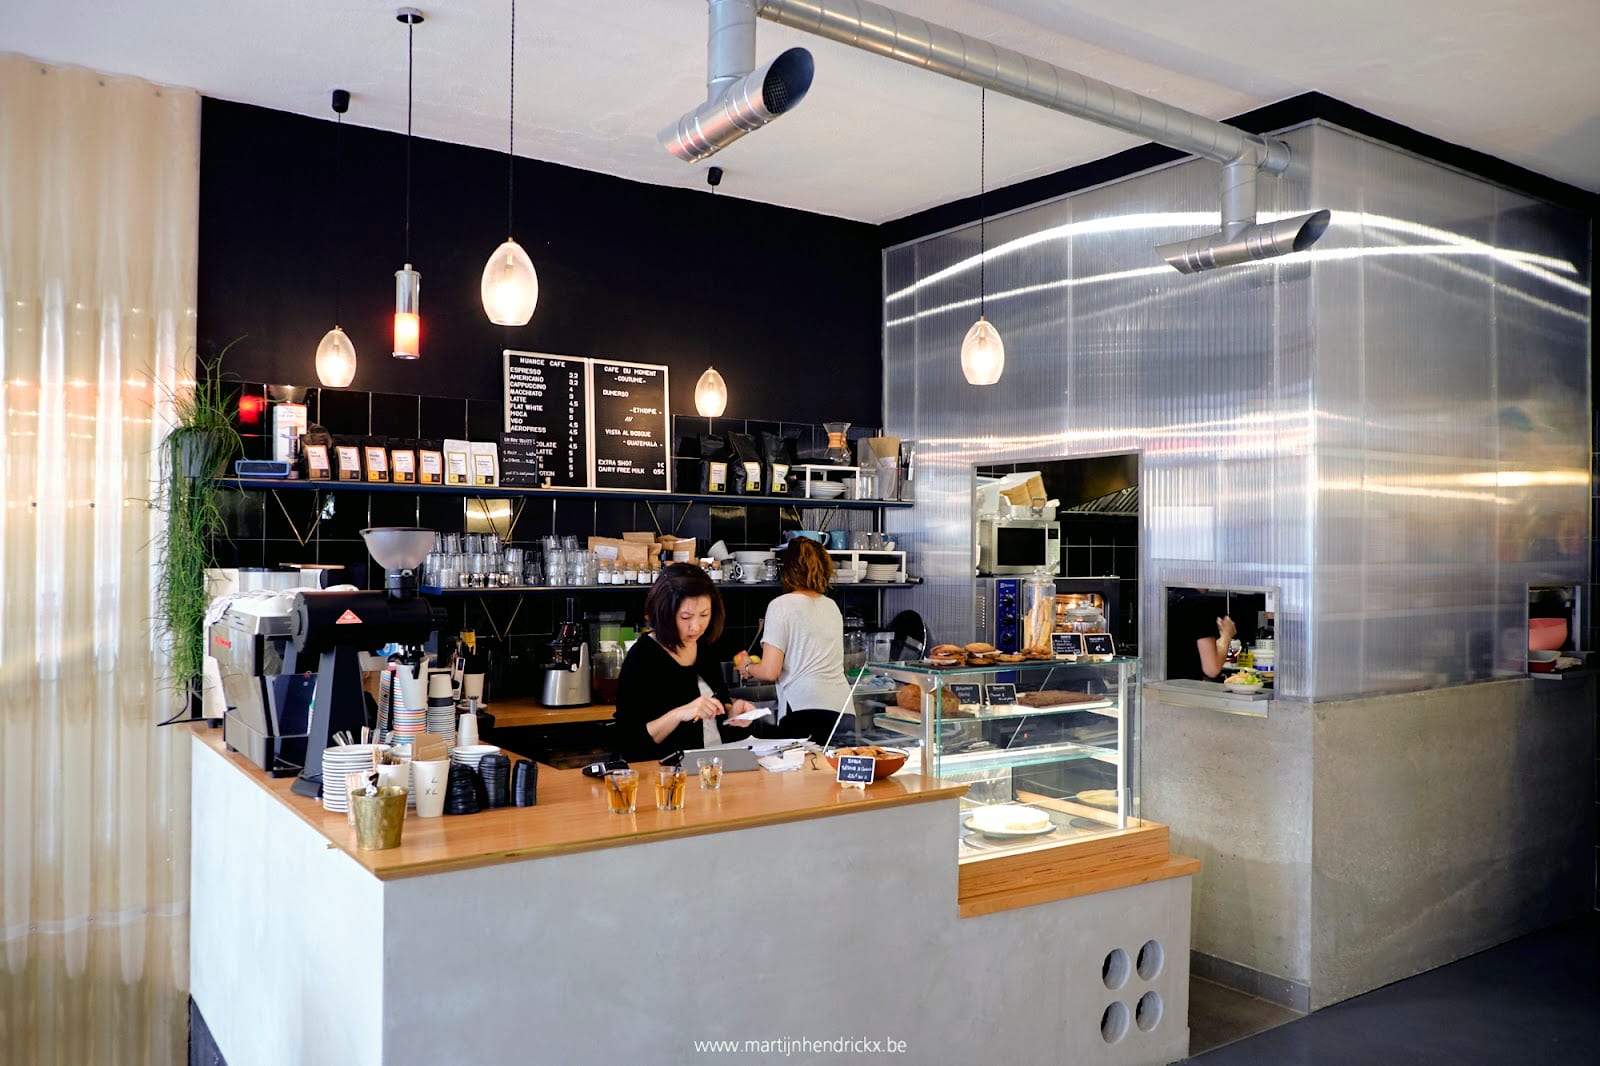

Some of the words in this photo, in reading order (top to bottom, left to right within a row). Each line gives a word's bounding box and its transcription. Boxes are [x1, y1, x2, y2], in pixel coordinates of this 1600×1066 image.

[520, 357, 545, 366] NUANCE
[549, 360, 566, 368] CAFE
[510, 366, 542, 375] ESPRESSO
[510, 374, 544, 382] AMERICANO
[510, 382, 546, 390] CAPPUCCINO
[510, 389, 542, 397] MACCHIATO
[602, 389, 629, 397] DUMERSO
[511, 425, 546, 433] AEROPRESS
